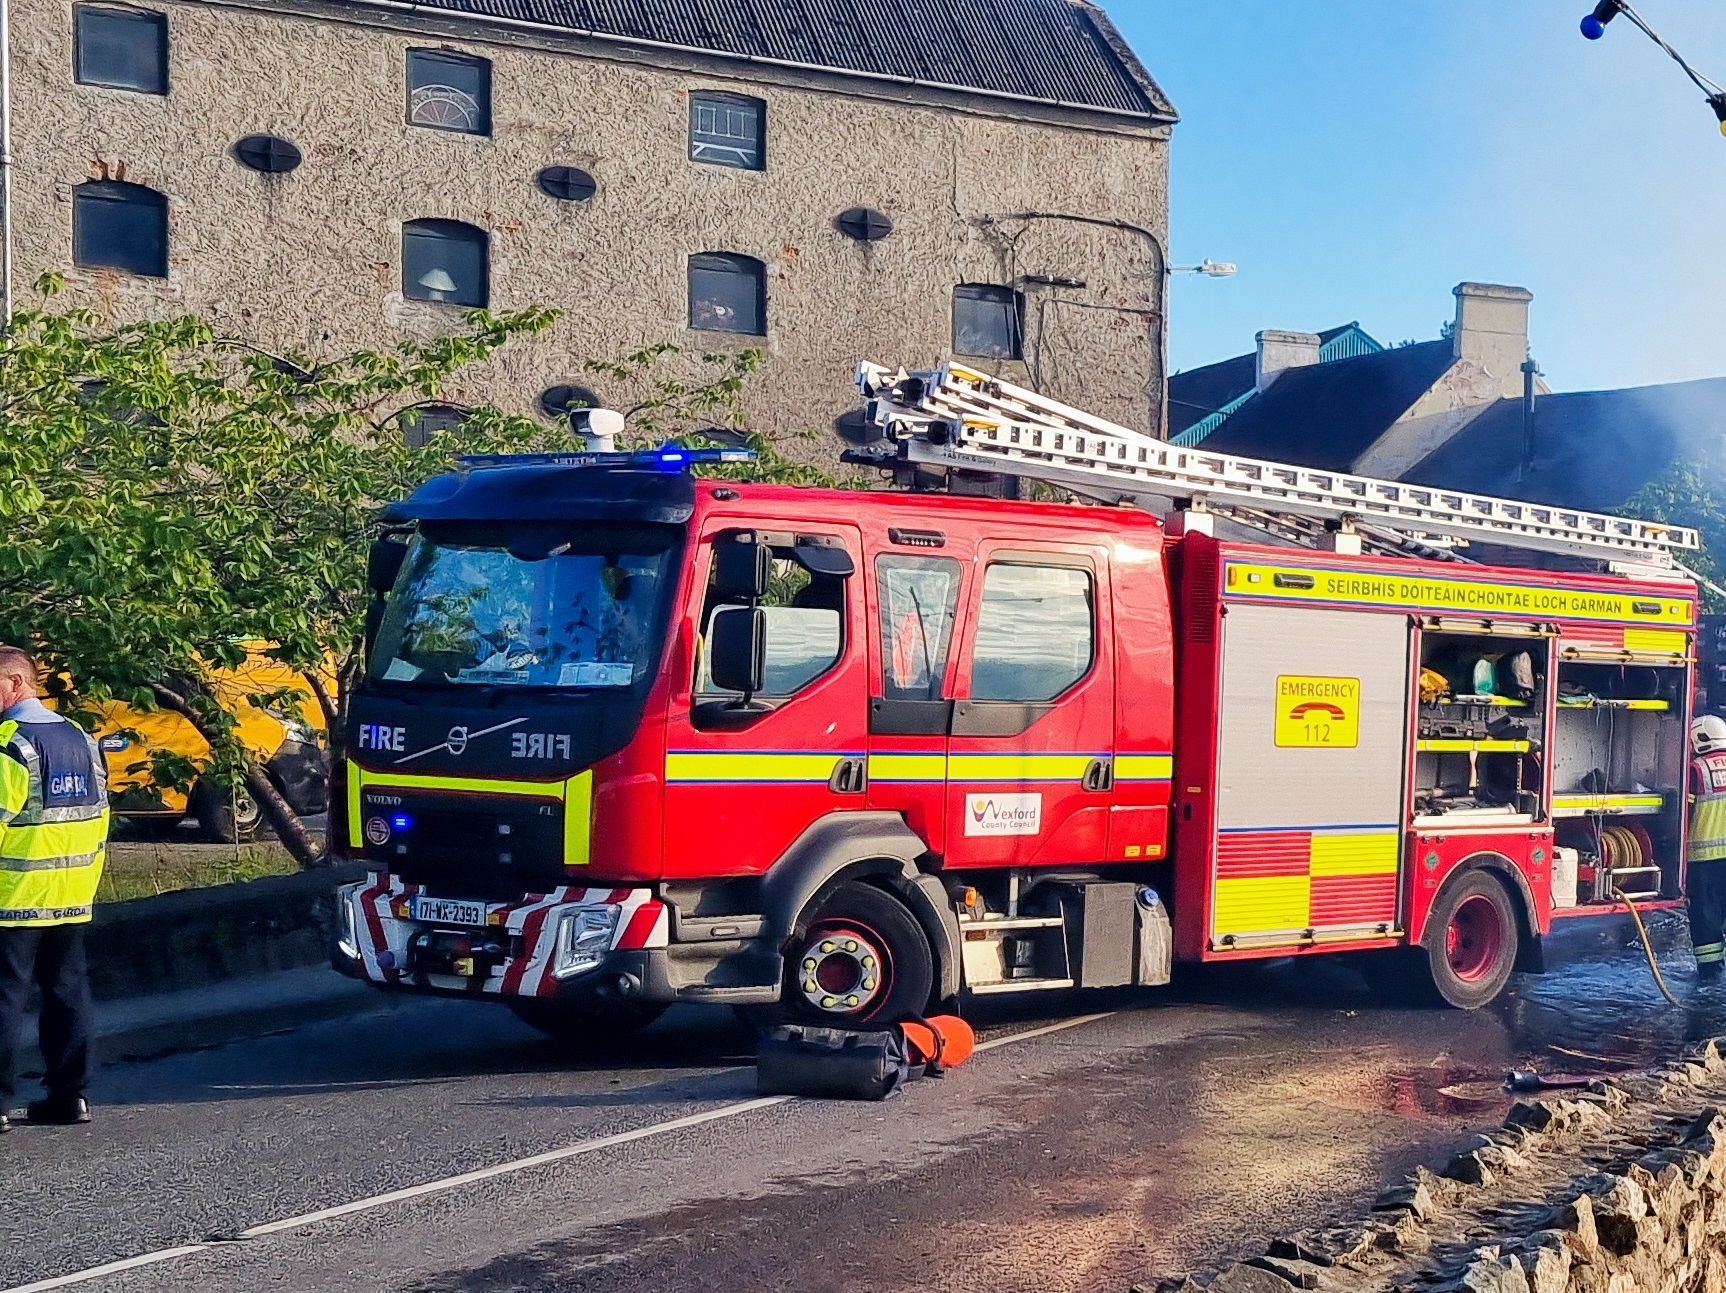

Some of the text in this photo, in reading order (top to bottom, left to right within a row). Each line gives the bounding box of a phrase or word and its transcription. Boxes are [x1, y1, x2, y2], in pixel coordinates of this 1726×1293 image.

[1327, 577, 1395, 598] SEIRBHÍS
[1534, 594, 1567, 611] LOCH
[1571, 597, 1622, 614] GARMAN
[1281, 682, 1355, 698] EMERGENCY
[358, 723, 406, 752] FIRE
[1304, 723, 1330, 742] 112
[366, 794, 402, 806] VOLVO
[970, 799, 1036, 823] Wexford
[981, 820, 1036, 830] County Council
[53, 907, 86, 919] GARDA
